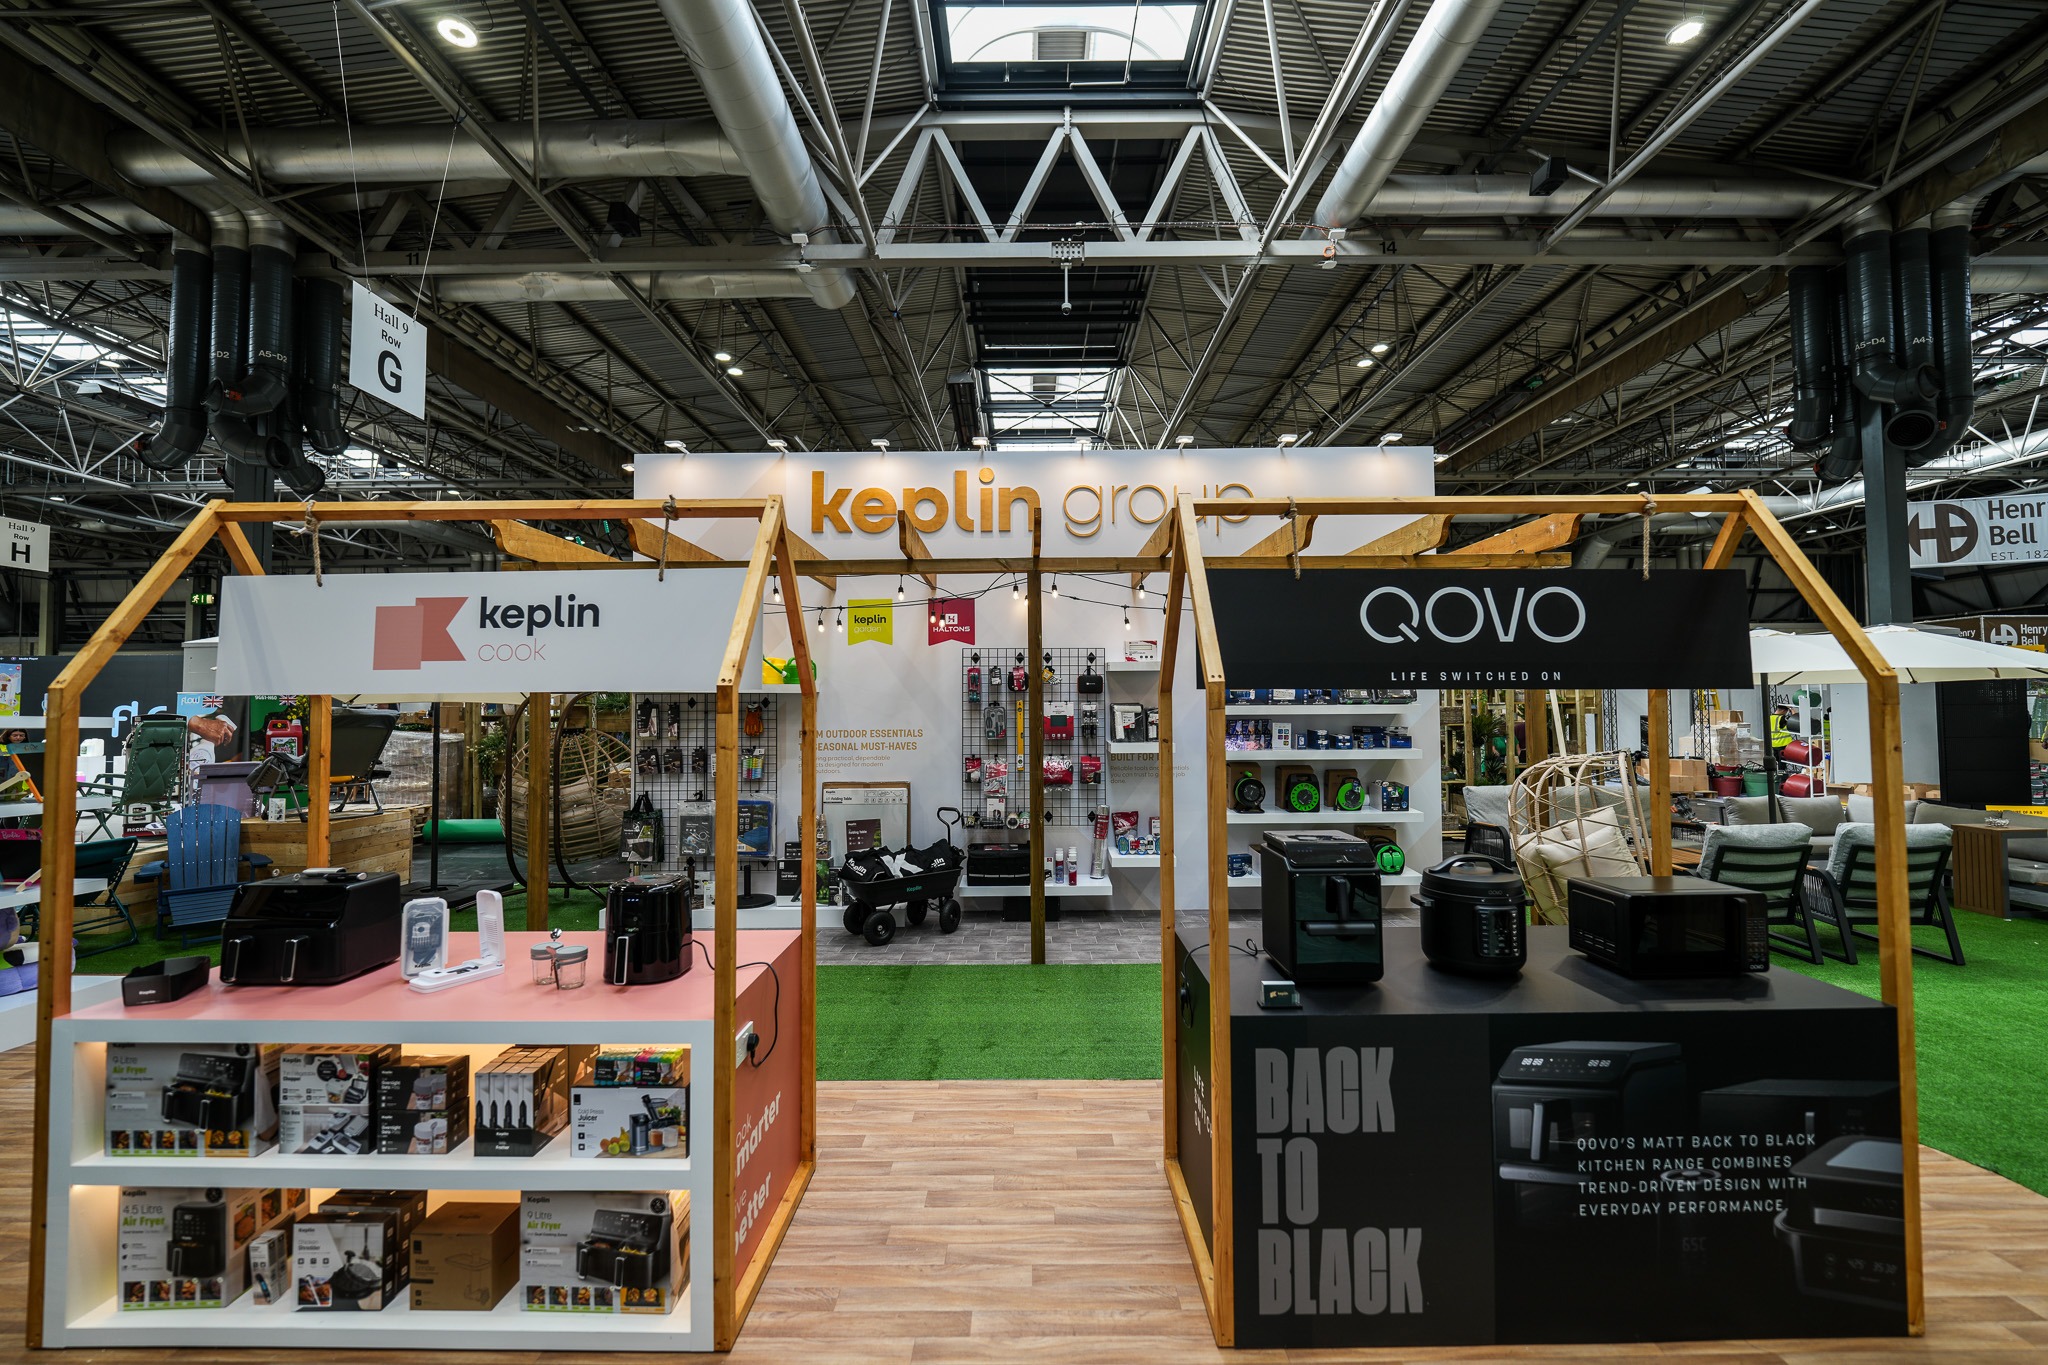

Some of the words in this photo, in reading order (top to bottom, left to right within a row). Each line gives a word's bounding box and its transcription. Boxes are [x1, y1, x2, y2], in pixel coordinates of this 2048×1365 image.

[1379, 241, 1396, 254] 14
[406, 252, 420, 266] 11
[374, 302, 399, 330] Hall
[402, 322, 410, 335] 9
[381, 329, 402, 349] Row
[377, 350, 402, 394] G
[810, 467, 1041, 534] keplin
[1986, 499, 2048, 521] Henr
[8, 521, 28, 532] Hall
[13, 533, 30, 541] Row
[1989, 522, 2038, 546] Bell
[11, 542, 31, 564] H
[1991, 551, 2019, 561] EST.
[479, 594, 600, 636] keplin
[853, 614, 887, 626] keplin
[1360, 586, 1586, 644] QOVO
[853, 625, 882, 633] garden
[1958, 627, 1976, 638] enry
[2020, 623, 2048, 636] Henry
[2021, 635, 2039, 646] Bell
[478, 638, 546, 663] cook
[1391, 671, 1428, 681] LIFE
[1440, 671, 1530, 681] SWITCHED
[1541, 671, 1562, 681] ON
[825, 729, 867, 739] OUTDOOR
[869, 728, 924, 738] ESSENTIALS
[860, 741, 918, 751] MUST-HAVES
[855, 754, 891, 763] dependable
[1110, 753, 1135, 762] BUILT
[1137, 753, 1155, 762] FOR
[824, 761, 851, 769] designed
[126, 1065, 148, 1075] Fryer
[1193, 1065, 1205, 1099] LIFE
[1255, 1046, 1395, 1134] BACK
[1194, 1110, 1201, 1135] ON
[735, 1113, 752, 1149] ook
[735, 1091, 781, 1178] marter
[1577, 1137, 1636, 1152] QOVO'S
[1643, 1135, 1684, 1149] MATT
[1691, 1135, 1733, 1148] BACK
[1739, 1135, 1758, 1147] TO
[1765, 1133, 1816, 1146] BLACK
[1577, 1158, 1646, 1172] KITCHEN
[1652, 1157, 1705, 1171] RANGE
[1711, 1155, 1792, 1169] COMBINES
[1257, 1137, 1319, 1225] TO
[1578, 1180, 1697, 1194] TREND-DRIVEN
[1703, 1178, 1761, 1191] DESIGN
[1767, 1177, 1808, 1190] WITH
[122, 1189, 147, 1198] Keplin
[527, 1196, 550, 1204] Keplin
[123, 1204, 139, 1215] 4.5
[141, 1205, 163, 1214] Litre
[527, 1210, 533, 1220] 9
[534, 1211, 553, 1220] Litre
[1579, 1202, 1662, 1216] EVERYDAY
[123, 1216, 137, 1226] Air
[139, 1216, 165, 1228] Fryer
[527, 1220, 539, 1230] Air
[541, 1220, 561, 1231] Fryer
[1258, 1227, 1423, 1315] BLACK
